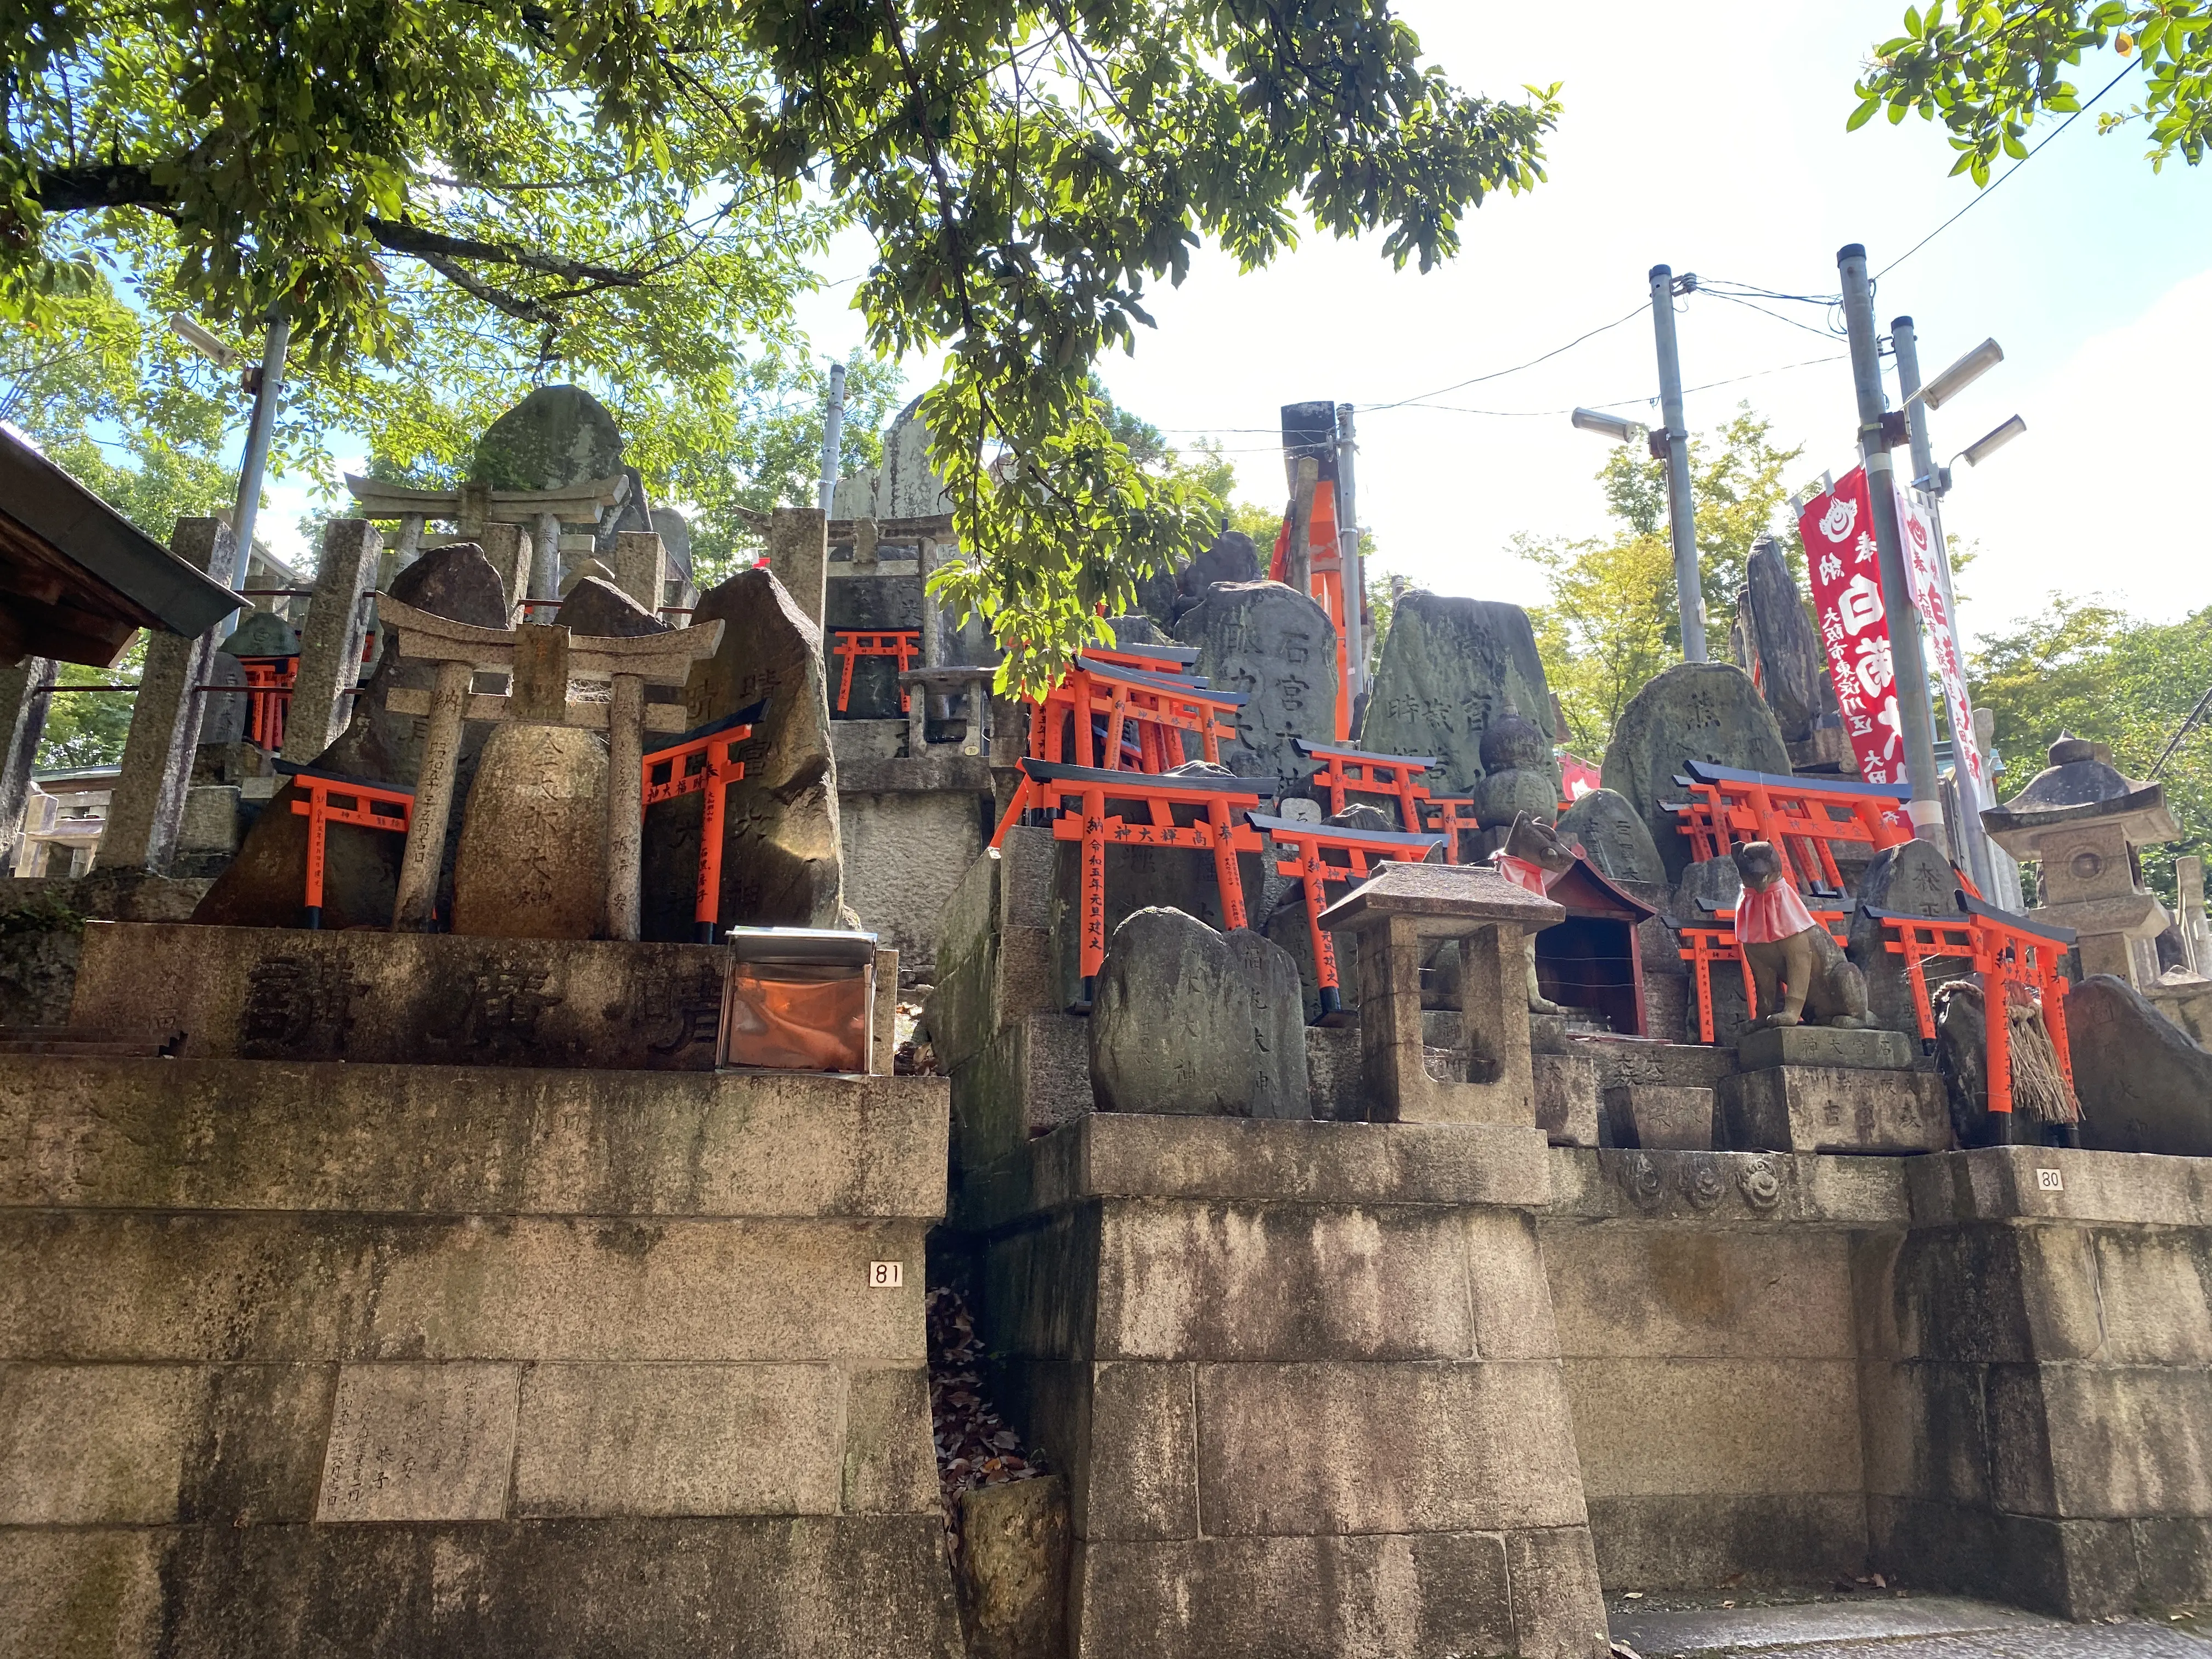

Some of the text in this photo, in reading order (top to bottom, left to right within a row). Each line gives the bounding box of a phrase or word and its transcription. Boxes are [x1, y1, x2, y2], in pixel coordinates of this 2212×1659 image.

[1917, 589, 1957, 701] 大阪市東淀川区
[1821, 607, 1873, 737] 大阪市東淀川区
[1086, 816, 1104, 834] 納
[1114, 825, 1207, 847] 高輝大神
[1218, 821, 1233, 846] 奉
[1087, 838, 1104, 950] 令和五年元旦建之
[2042, 1172, 2058, 1187] 80
[876, 1264, 898, 1284] 81
